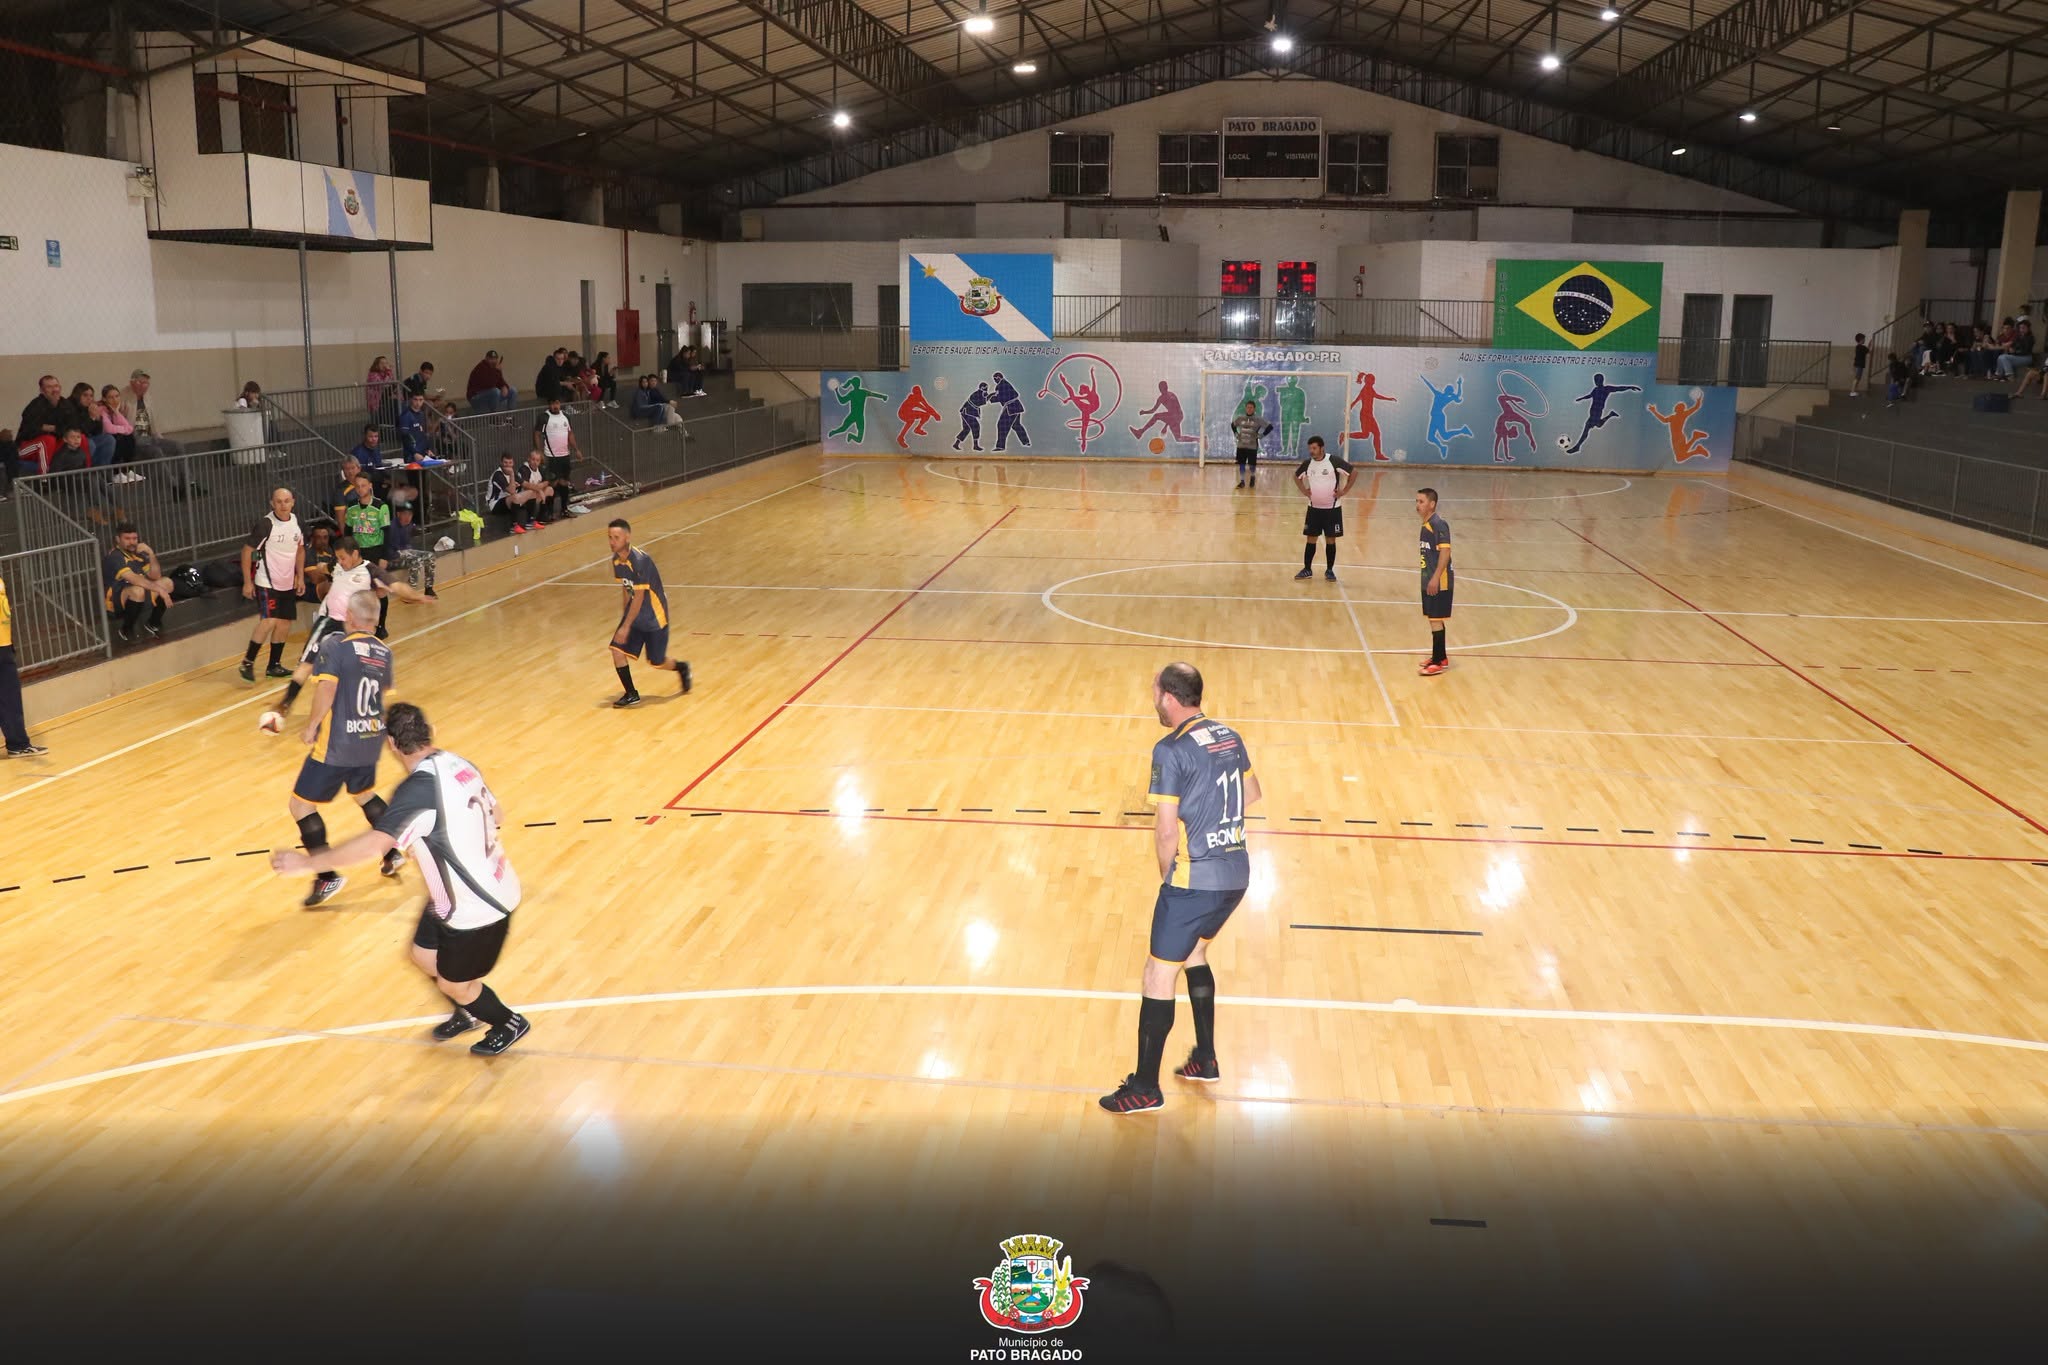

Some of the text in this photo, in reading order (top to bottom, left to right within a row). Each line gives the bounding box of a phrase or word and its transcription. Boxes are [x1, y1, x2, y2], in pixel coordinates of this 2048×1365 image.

[1228, 121, 1317, 132] PATO BRAGADO
[1285, 152, 1318, 160] VISITANTE
[975, 346, 1012, 356] DISCIPLINA
[1204, 350, 1241, 362] PATO
[1552, 355, 1581, 365] DENTRO
[1215, 767, 1243, 824] 11
